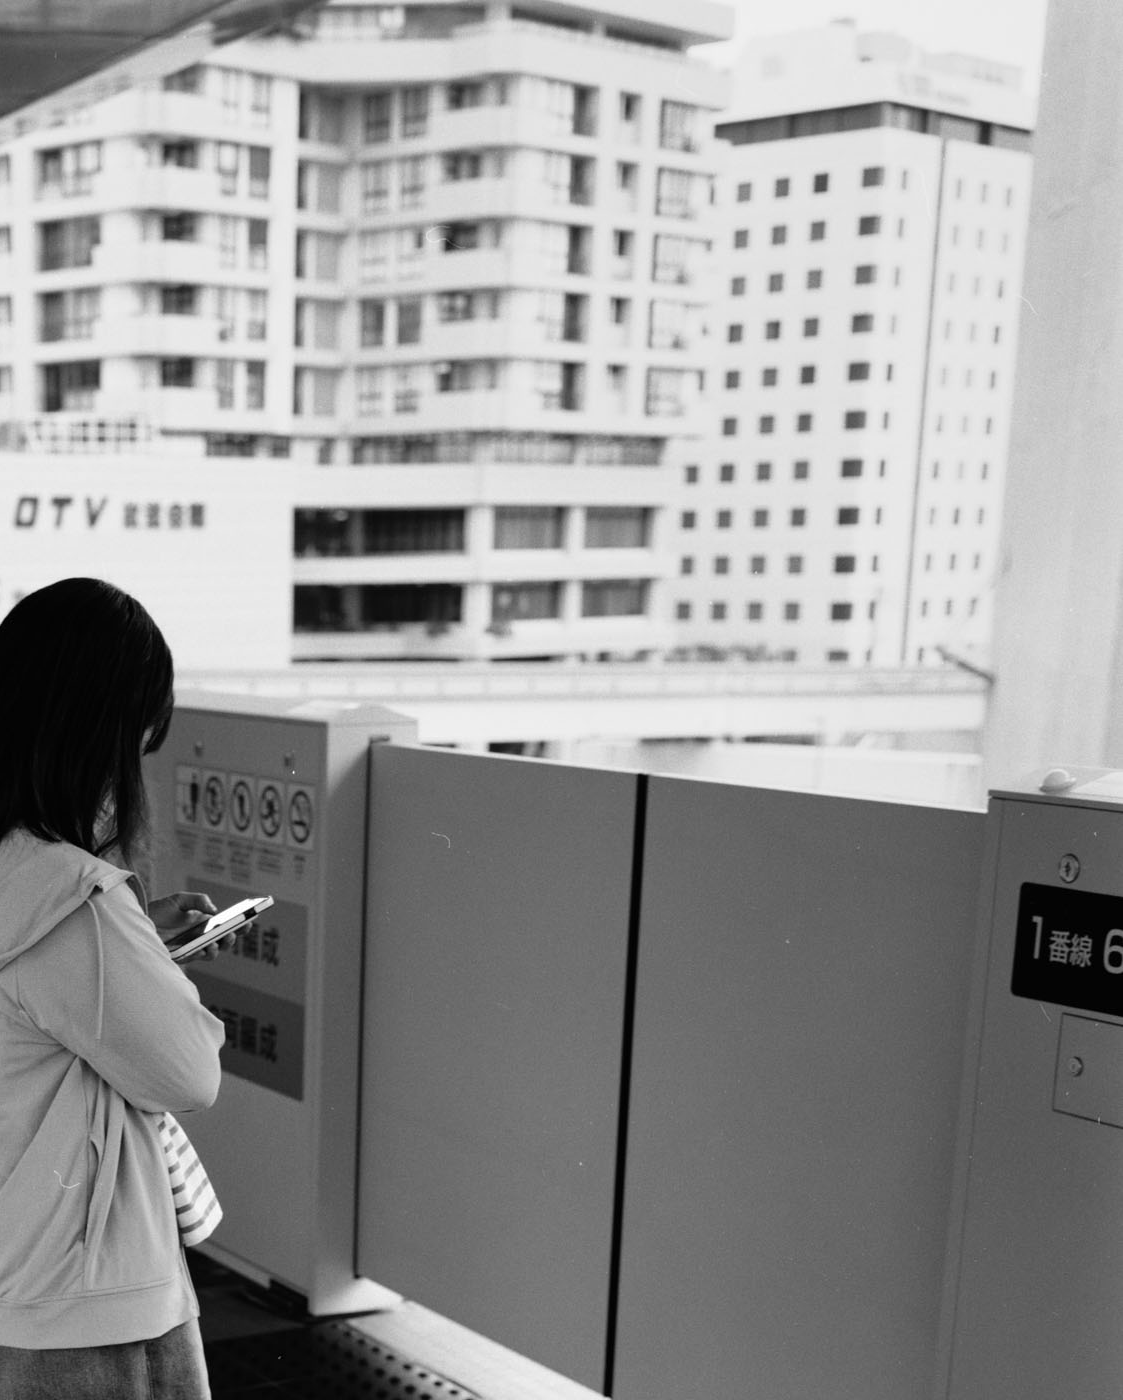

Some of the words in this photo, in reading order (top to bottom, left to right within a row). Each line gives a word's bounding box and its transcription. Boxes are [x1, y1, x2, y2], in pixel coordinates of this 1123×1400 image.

[15, 496, 108, 528] OTV
[1032, 915, 1093, 968] 1番線
[1103, 928, 1123, 975] 6
